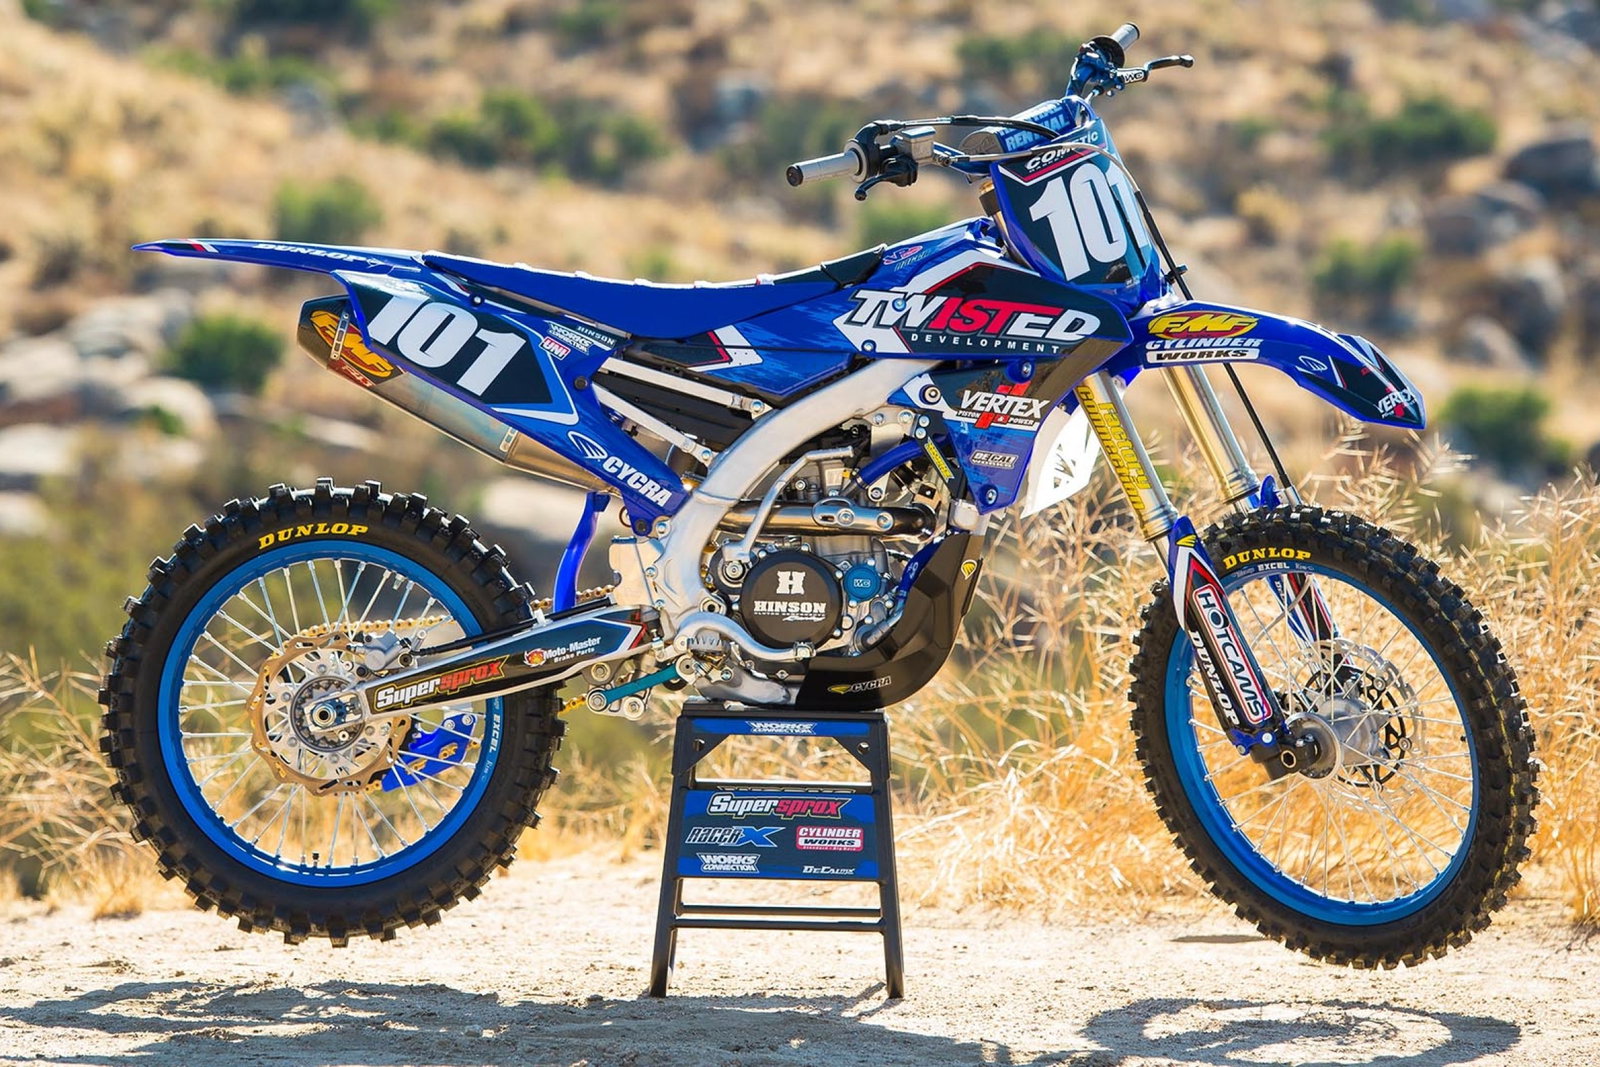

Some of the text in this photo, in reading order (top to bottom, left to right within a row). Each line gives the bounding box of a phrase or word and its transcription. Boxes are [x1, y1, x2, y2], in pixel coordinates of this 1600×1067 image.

[1029, 163, 1149, 281] 101
[253, 243, 367, 262] DUNLOP
[1149, 313, 1259, 334] FMF
[367, 294, 526, 397] 101
[550, 324, 593, 348] WORKS
[577, 325, 616, 346] HINSON
[911, 334, 1060, 354] DEVELOPMENT
[1145, 337, 1264, 350] CYLINDER
[542, 338, 569, 358] UNI
[1156, 350, 1249, 361] WORKS
[960, 389, 1051, 419] VERTEX
[957, 410, 1034, 427] PISTON POWER
[1098, 402, 1153, 489] Factory
[603, 456, 672, 507] CYCRA
[258, 522, 369, 550] DUNLOP
[1223, 547, 1312, 569] DUNLOP
[1257, 562, 1290, 572] EXCEL
[776, 570, 806, 595] H
[754, 600, 827, 613] HINSON
[543, 636, 601, 660] Moto-Master
[554, 647, 595, 663] Brake Parts
[1197, 591, 1263, 717] HOTCAMS
[376, 660, 502, 708] Supersprox
[848, 676, 892, 694] CYCRA
[1188, 630, 1241, 726] DUNLOP
[489, 714, 501, 753] EXCEL
[751, 721, 813, 730] WORKS
[710, 794, 842, 816] Supersprox
[799, 827, 861, 838] CYLINDER
[804, 838, 856, 846] WORKS
[701, 854, 757, 865] WORKS
[703, 863, 756, 871] CONNECTION
